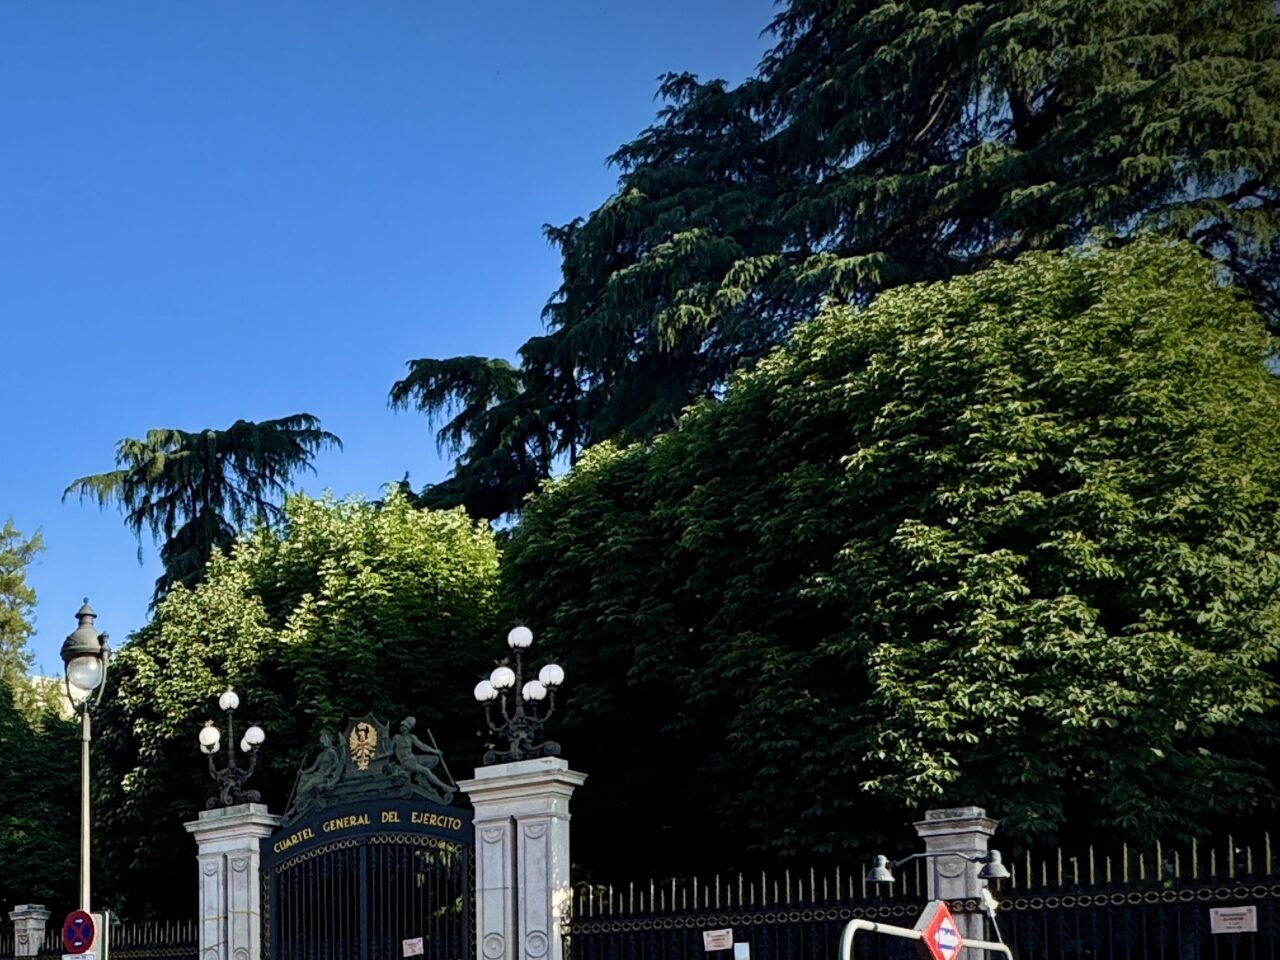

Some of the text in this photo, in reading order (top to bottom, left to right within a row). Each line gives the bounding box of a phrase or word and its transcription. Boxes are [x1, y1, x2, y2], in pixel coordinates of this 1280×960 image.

[273, 811, 461, 852] CUARTEL GENERAL DEL EJERCITO
